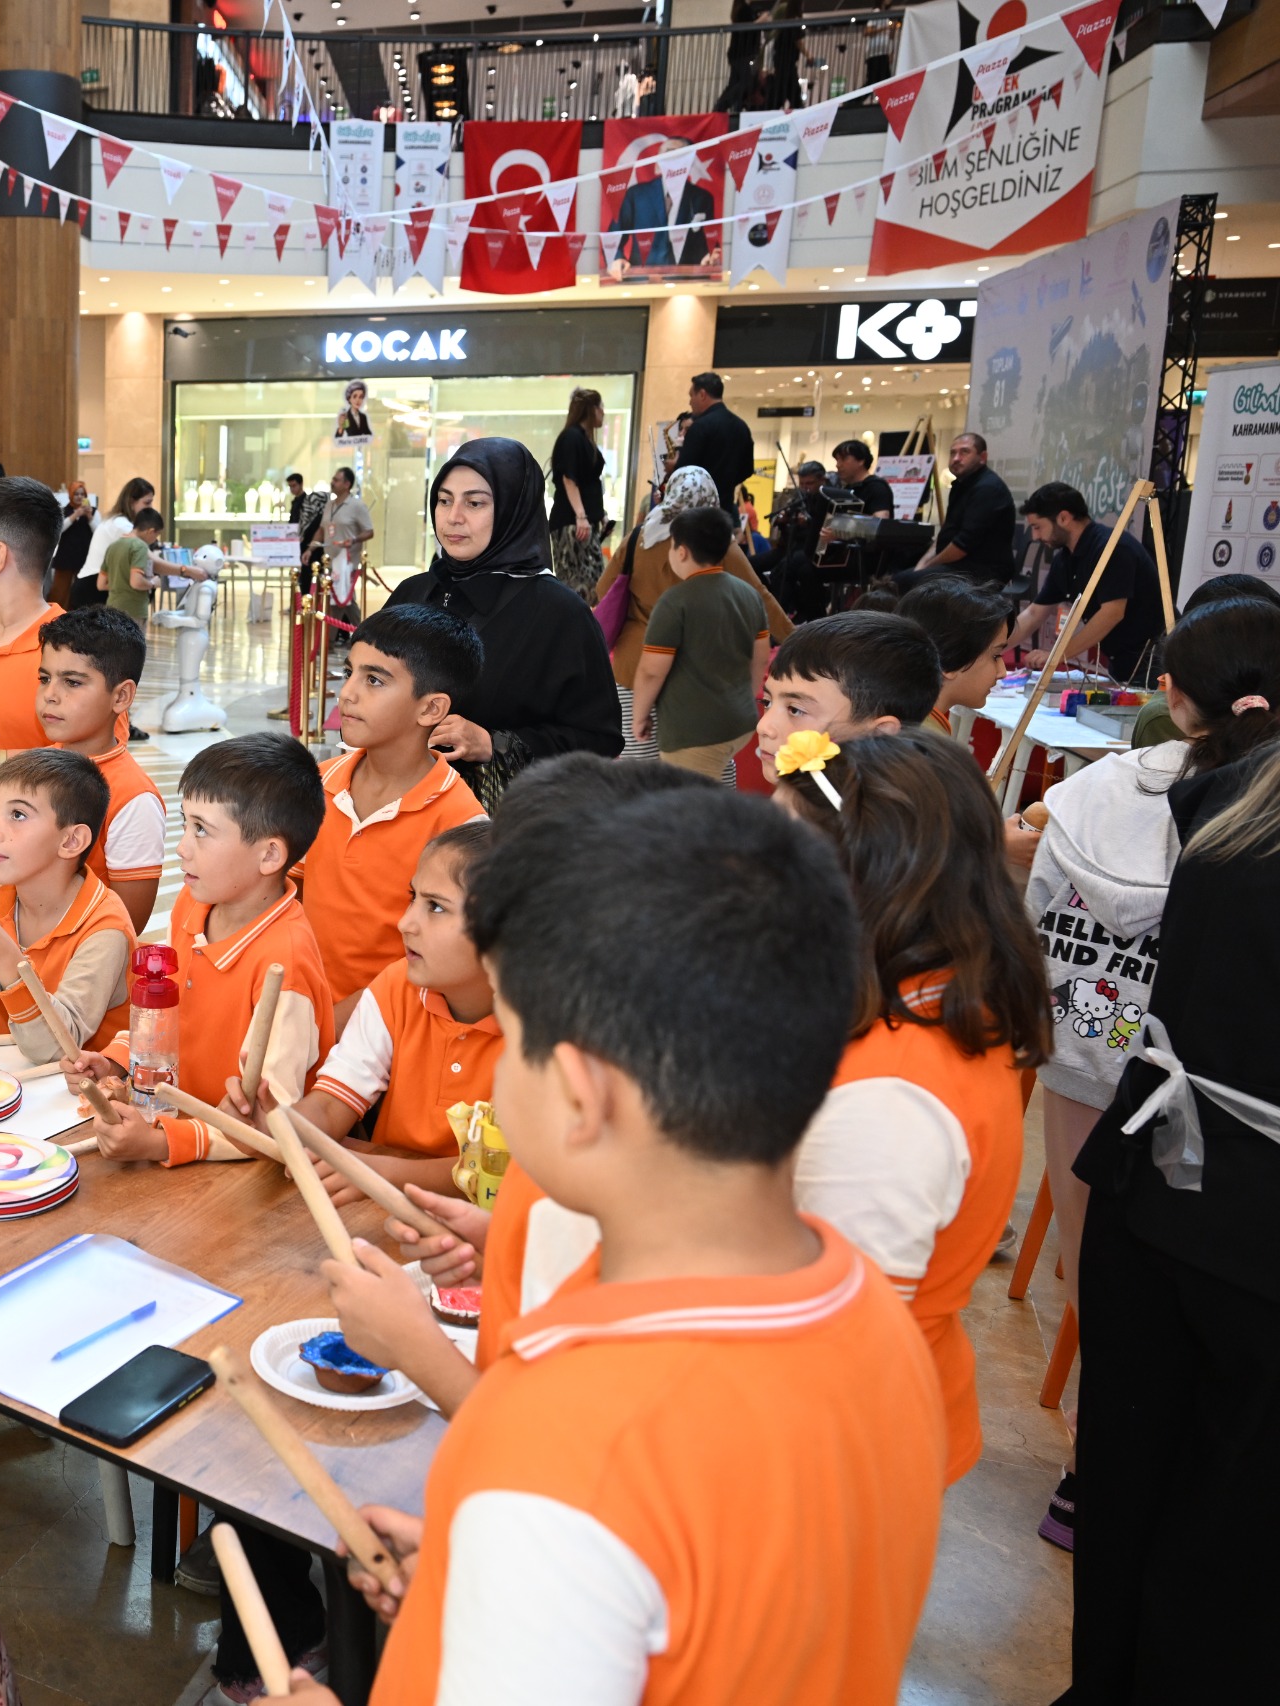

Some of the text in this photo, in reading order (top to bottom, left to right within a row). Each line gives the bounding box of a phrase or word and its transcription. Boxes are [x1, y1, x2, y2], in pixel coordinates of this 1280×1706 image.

[1075, 15, 1112, 38] Piazza
[975, 56, 1009, 77] Piazza
[885, 91, 916, 110] Piazza
[802, 122, 829, 139] Piazza
[728, 146, 753, 161] Piazza
[916, 126, 1081, 188] BİLM ŞENLİĞİNE
[666, 166, 688, 179] Piazza
[919, 166, 1064, 219] HOŞGELDİNİZ
[1202, 311, 1239, 320] ANIŞMA
